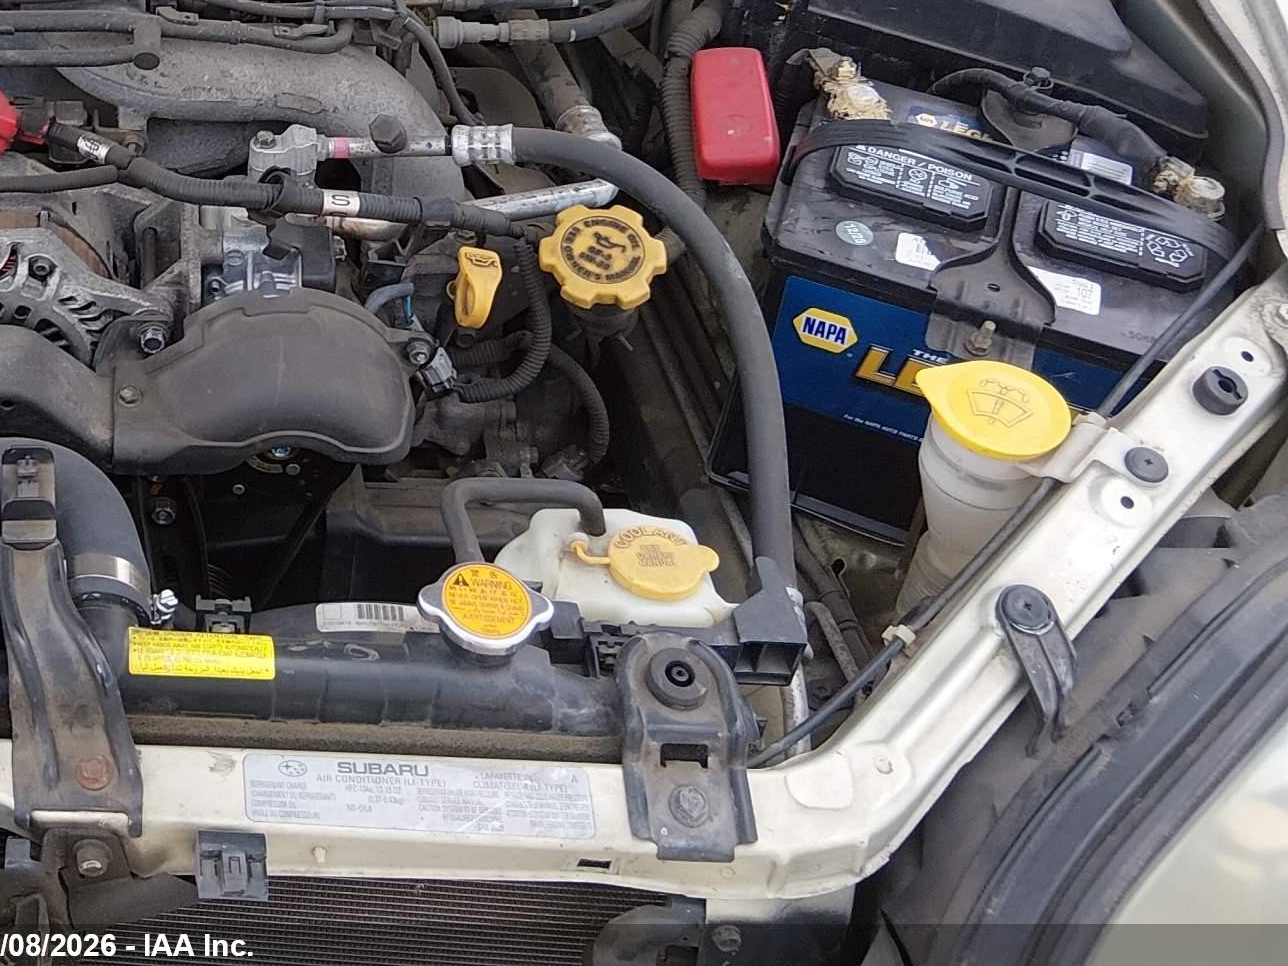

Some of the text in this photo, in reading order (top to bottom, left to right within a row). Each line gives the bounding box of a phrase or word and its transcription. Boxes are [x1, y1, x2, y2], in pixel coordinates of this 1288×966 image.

[867, 146, 917, 165] DANGER
[927, 163, 972, 181] POISON
[802, 316, 848, 345] NAPA
[911, 348, 950, 365] THE
[470, 577, 513, 590] WARNING
[471, 594, 488, 602] OPEN
[337, 761, 429, 777] SUBARU
[316, 774, 333, 783] AIR
[335, 775, 402, 786] CONDITIONER
[570, 775, 578, 784] A
